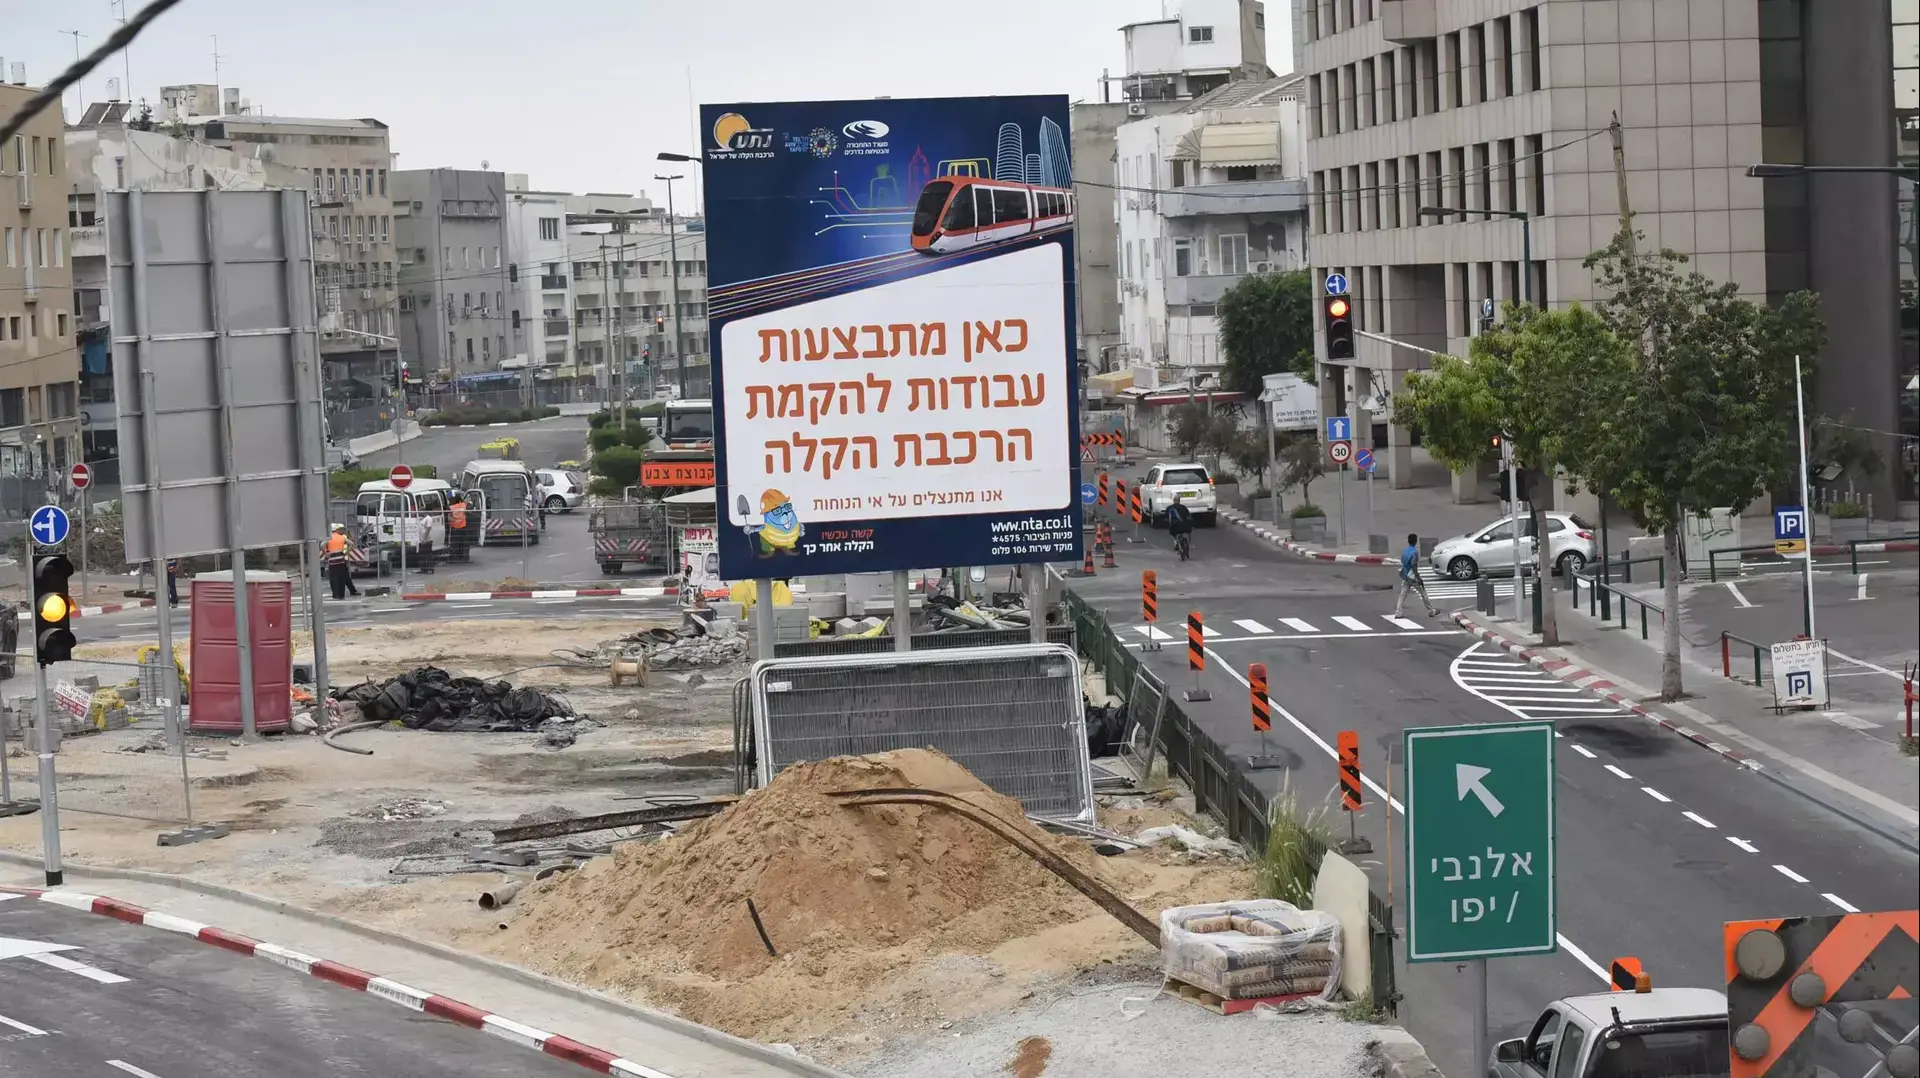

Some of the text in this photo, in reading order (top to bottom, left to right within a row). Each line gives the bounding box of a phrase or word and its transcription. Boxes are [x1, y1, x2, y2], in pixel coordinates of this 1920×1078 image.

[758, 318, 1028, 363] כאן מתבצעות
[745, 373, 1044, 425] עבודות להקמת
[764, 428, 1033, 480] הרכבת הקלה
[1335, 448, 1347, 457] 30
[646, 469, 670, 479] צבע
[813, 490, 1002, 511] אנו מתנצלים על אי הנוחות
[991, 515, 1072, 532] www.nta.co.il
[1786, 518, 1798, 532] P
[821, 528, 874, 540] קשה עכשיו
[1023, 533, 1050, 541] הציבור:
[1053, 531, 1073, 540] פניות
[803, 540, 874, 555] הקלה אחר כך
[992, 546, 1010, 555] פלוס
[1029, 544, 1051, 553] שירות
[1053, 543, 1073, 552] מוקד
[1774, 641, 1820, 653] חניון בתשלום
[1795, 679, 1805, 694] P
[1431, 846, 1533, 881] אלנבי
